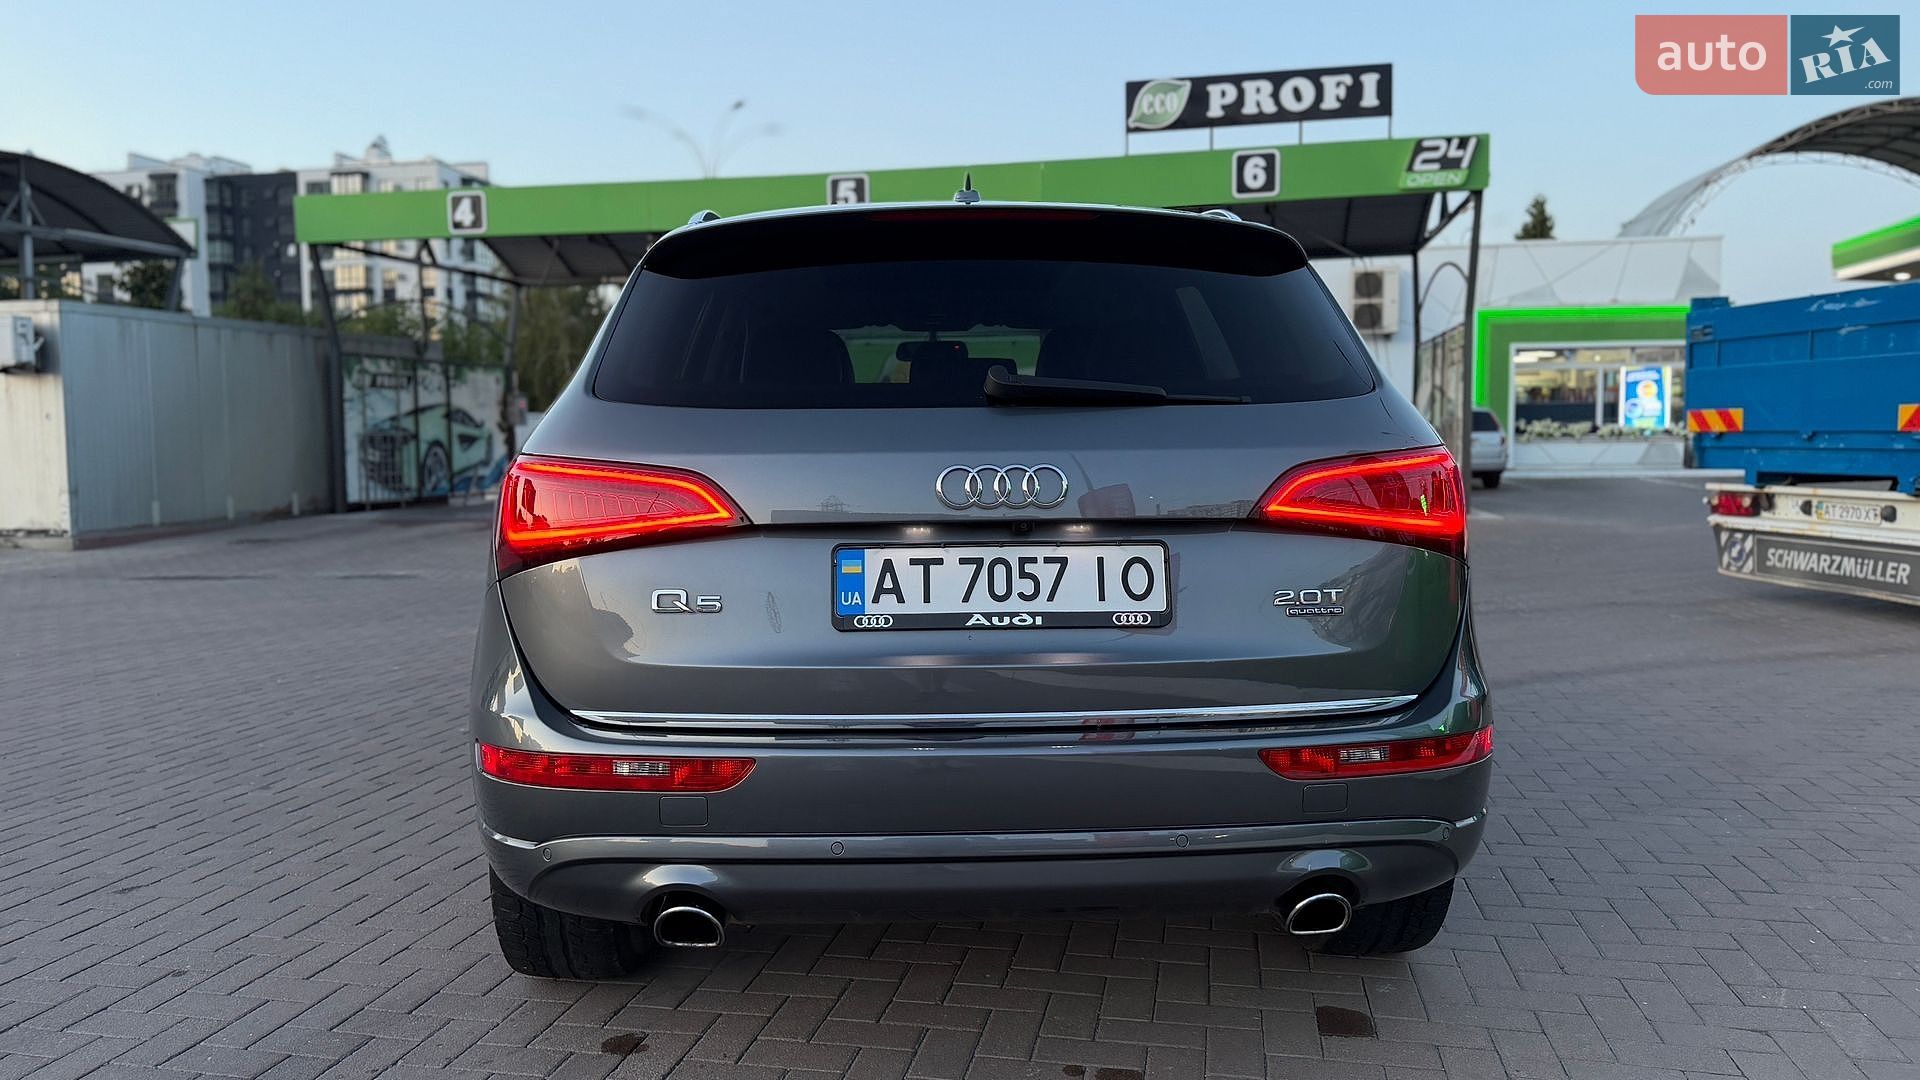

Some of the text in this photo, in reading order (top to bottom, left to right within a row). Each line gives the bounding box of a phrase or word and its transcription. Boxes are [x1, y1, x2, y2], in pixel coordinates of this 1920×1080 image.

[1206, 72, 1381, 118] PROFI
[1412, 136, 1478, 172] 24
[1243, 156, 1267, 190] 6
[1407, 172, 1462, 187] OPEN
[836, 180, 858, 206] 5
[454, 197, 476, 227] 4
[871, 556, 1155, 604] AT 7057 IO
[651, 589, 722, 613] Q5
[841, 591, 862, 605] UA
[1273, 588, 1344, 605] 2.0T
[965, 613, 1043, 626] Audi
[1289, 607, 1342, 616] quattro
